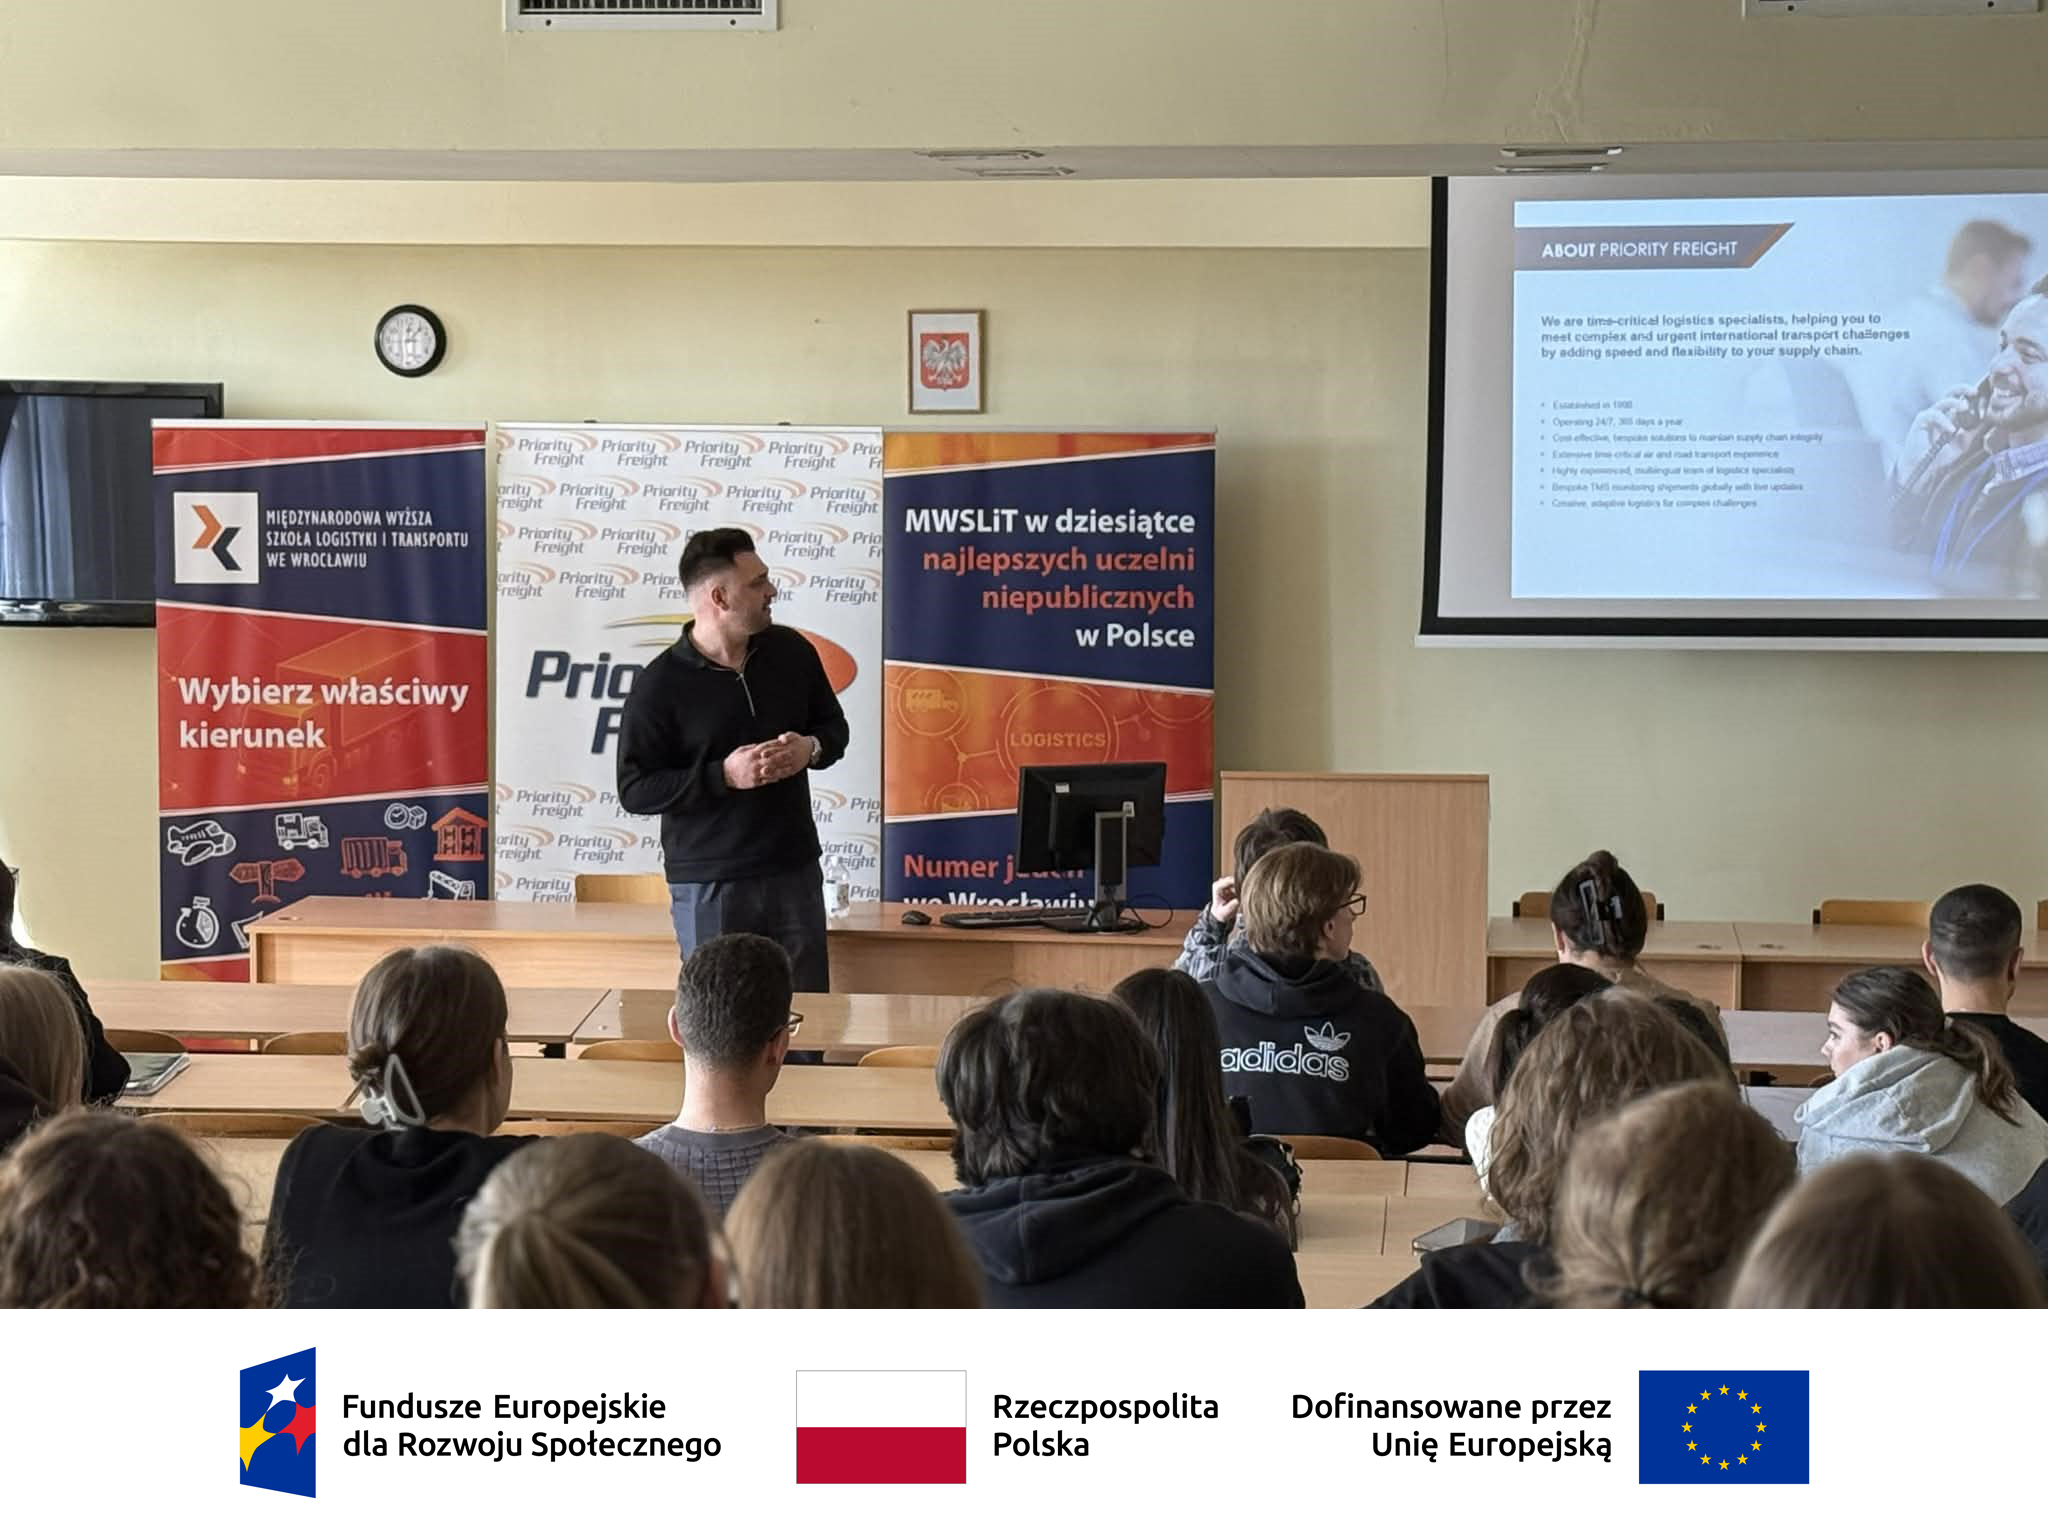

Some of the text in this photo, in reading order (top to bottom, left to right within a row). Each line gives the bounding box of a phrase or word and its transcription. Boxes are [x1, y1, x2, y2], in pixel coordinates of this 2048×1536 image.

[1542, 240, 1738, 258] ABOUT PRIORITY FREIGHT
[1541, 313, 1881, 328] We are time-critical logistics specialists, helping you to
[1541, 328, 1911, 344] meet complex and urgent international transport challenges
[1541, 344, 1862, 359] by adding speed and flexibility to your supply chain.
[519, 438, 573, 454] Priority
[602, 439, 656, 455] Priority
[685, 440, 739, 455] Priority
[768, 441, 823, 456] Priority
[852, 442, 881, 455] Prio
[534, 453, 584, 468] Freight
[617, 453, 668, 469] Freight
[700, 454, 752, 470] Freight
[784, 455, 836, 471] Freight
[497, 483, 531, 498] ority
[559, 483, 614, 498] Priority
[642, 484, 697, 499] Priority
[726, 485, 781, 500] Priority
[810, 486, 866, 501] Priority
[575, 498, 627, 512] Freight
[659, 499, 710, 514] Freight
[742, 499, 794, 515] Freight
[826, 501, 879, 516] Freight
[267, 507, 432, 529] MIĘDZYNARODOWA WYŻSZA
[905, 507, 1195, 539] MWSLiT w dziesiątce
[267, 531, 469, 548] SZKOŁA LOGISTYKI I TRANSPORTU
[518, 527, 573, 542] Priority
[601, 528, 656, 543] Priority
[768, 530, 823, 545] Priority
[852, 531, 881, 544] Prio
[534, 541, 584, 556] Freight
[617, 542, 668, 557] Freight
[784, 545, 836, 560] Freight
[267, 552, 367, 569] WE WROCŁAWIU
[923, 546, 1195, 576] najlepszych uczelni
[497, 571, 531, 585] ority
[559, 571, 614, 586] Priority
[809, 575, 865, 590] Priority
[575, 586, 626, 601] Freight
[825, 591, 879, 606] Freight
[982, 584, 1195, 615] niepublicznych
[1075, 623, 1195, 647] w Polsce
[526, 650, 642, 699] Prio
[178, 676, 469, 713] Wybierz właściwy
[180, 720, 326, 749] kierunek
[1009, 732, 1106, 748] LOGISTICS
[517, 790, 571, 804] Priority
[851, 797, 880, 810] Prio
[532, 804, 583, 819] Freight
[496, 834, 530, 848] ority
[558, 834, 612, 849] Priority
[573, 849, 624, 864] Freight
[904, 855, 999, 879] Numer
[516, 877, 570, 892] Priority
[850, 885, 880, 899] Prio
[1220, 1042, 1349, 1081] adidas
